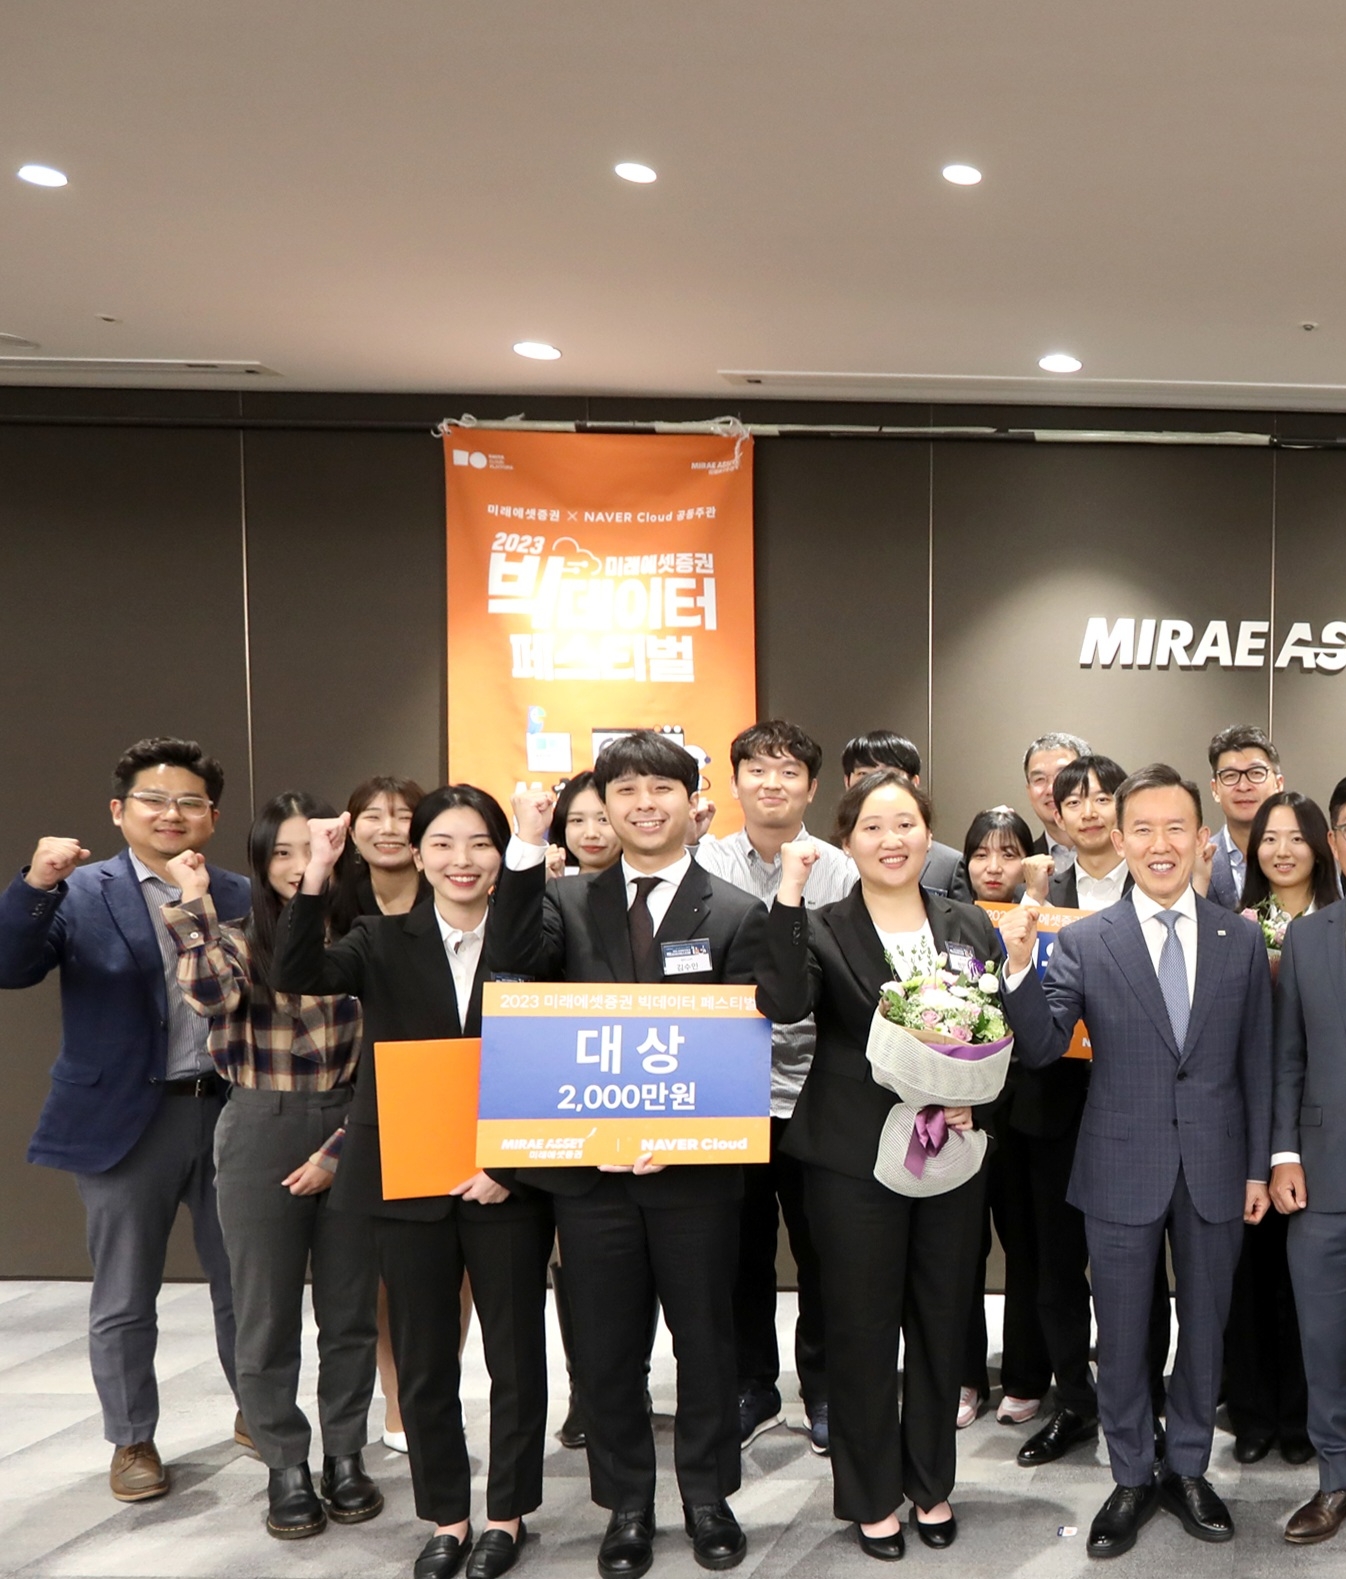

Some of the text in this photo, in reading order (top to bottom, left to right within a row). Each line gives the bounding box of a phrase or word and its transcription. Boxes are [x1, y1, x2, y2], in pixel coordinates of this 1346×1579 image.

[487, 504, 560, 521] 미래에셋증권
[584, 511, 632, 523] NAVER
[637, 511, 673, 523] Cloud
[676, 507, 716, 522] 공동주관
[492, 532, 546, 555] 2023
[605, 553, 714, 577] 미래에셋증권
[1079, 616, 1270, 667] MIRAE
[510, 634, 695, 683] 페스티벌
[500, 994, 539, 1009] 2023
[544, 994, 633, 1010] 미래에셋증권
[638, 994, 696, 1010] 빅데이터
[557, 1082, 696, 1112] 2,000만원
[501, 1137, 586, 1150] MIRAE ASSET
[641, 1137, 748, 1151] NAVER Cloud
